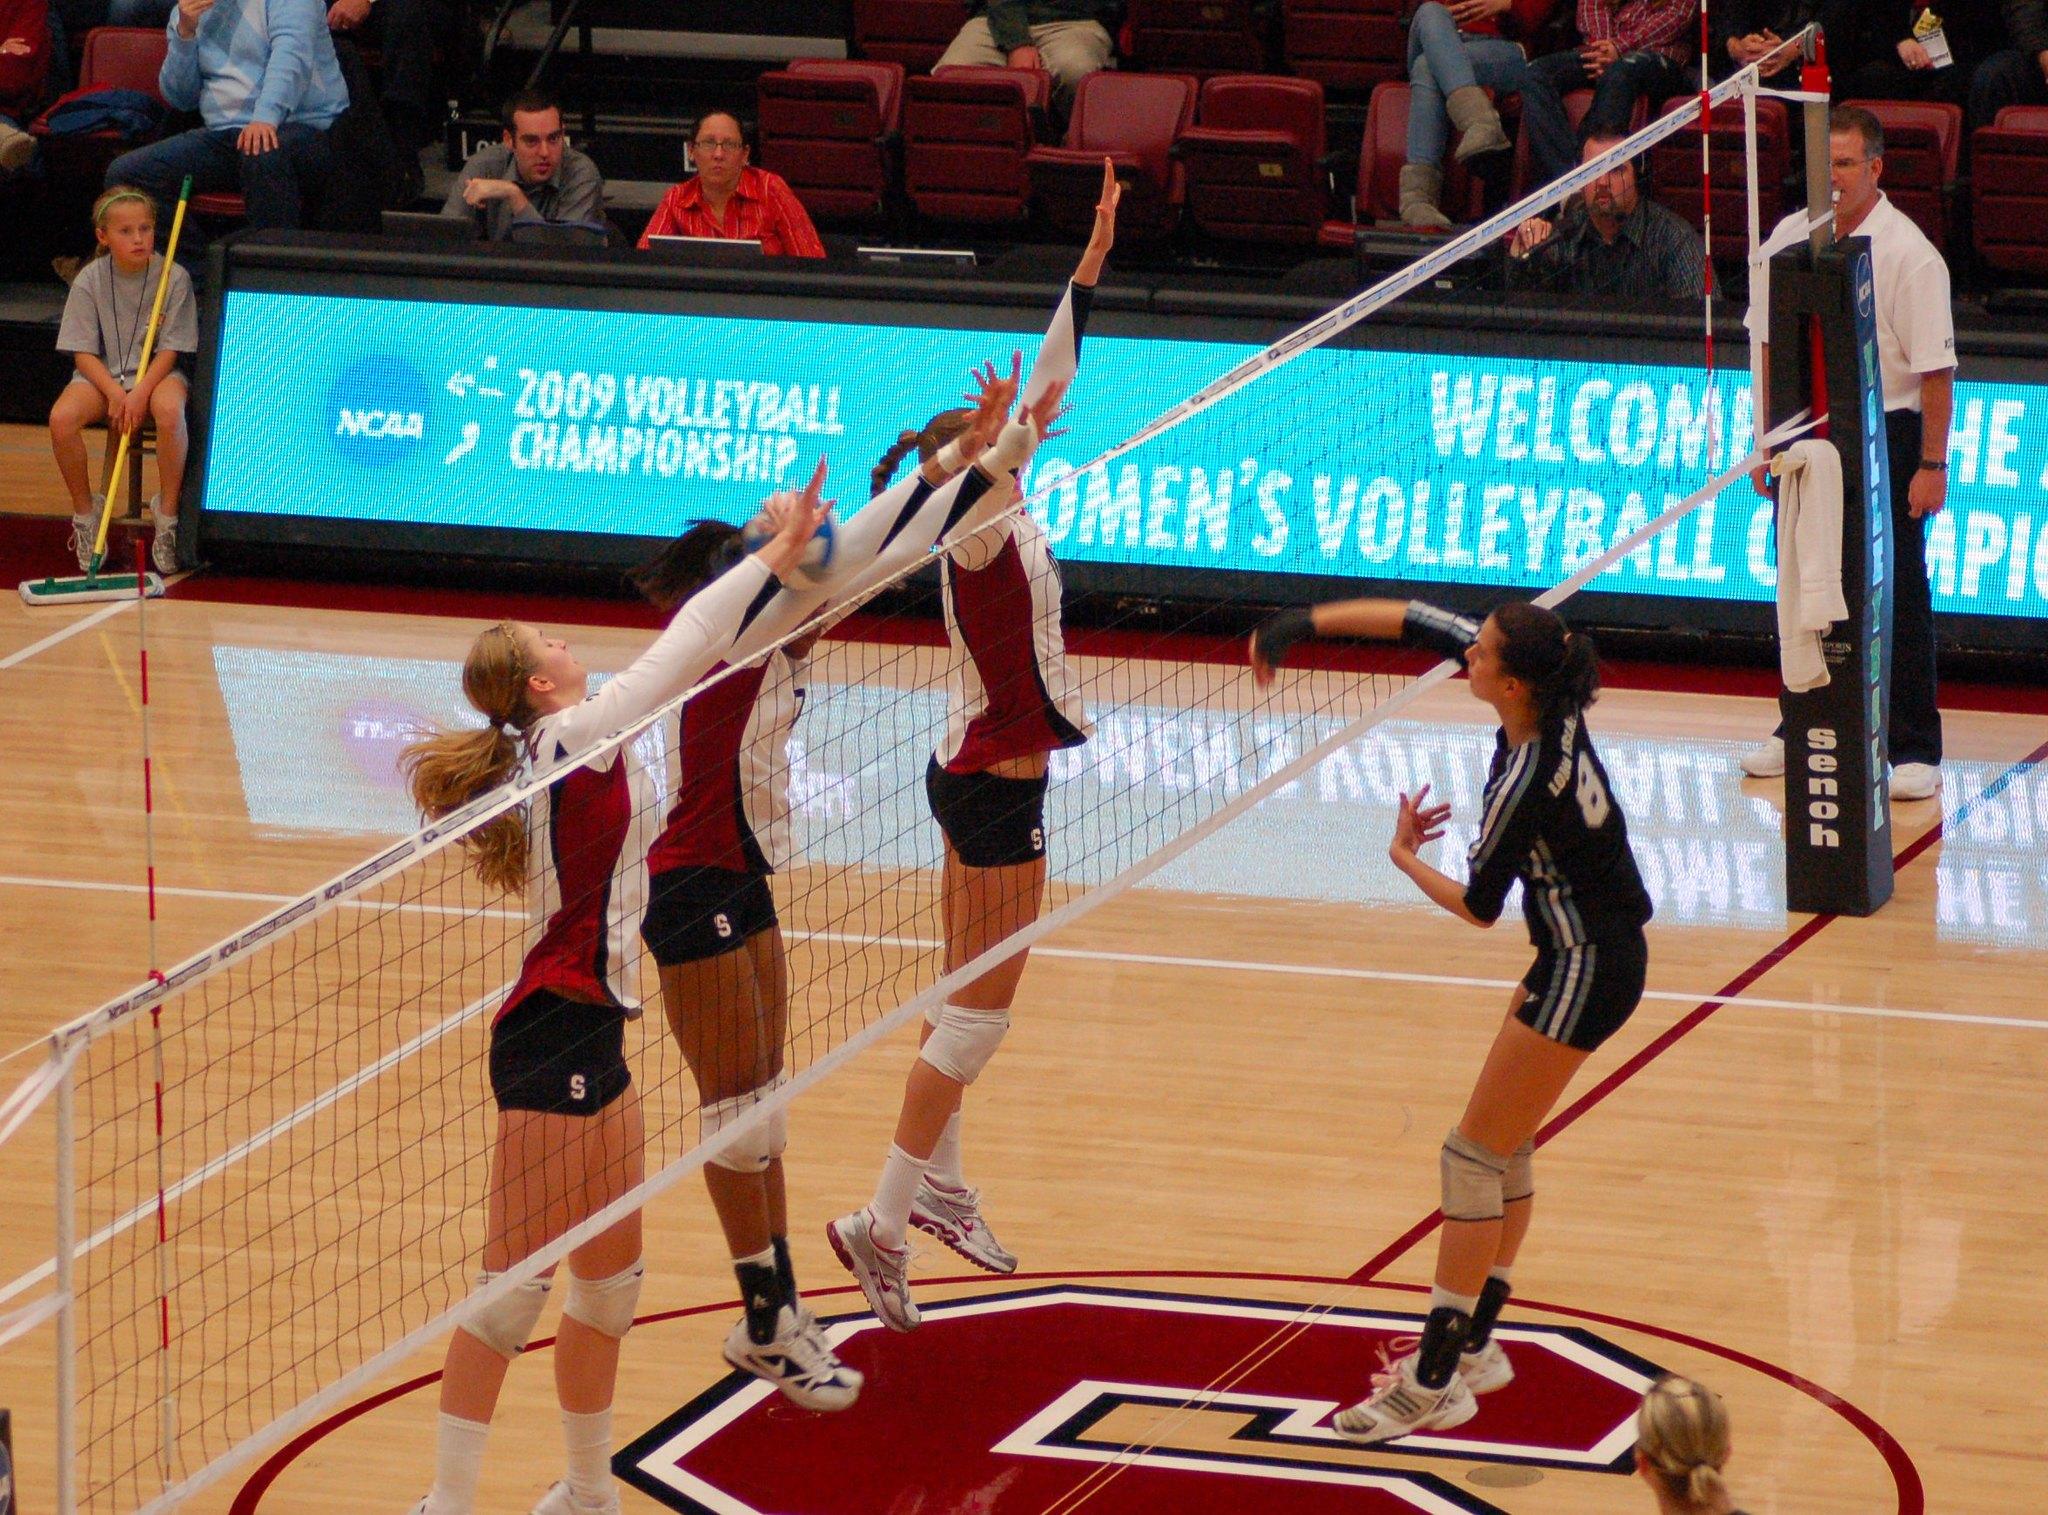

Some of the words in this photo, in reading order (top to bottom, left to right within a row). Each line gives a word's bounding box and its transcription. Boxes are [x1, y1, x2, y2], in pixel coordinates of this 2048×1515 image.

[336, 408, 424, 439] NCAA
[513, 368, 617, 421] 2009
[625, 375, 845, 435] VOLLEYBALL
[510, 421, 797, 483] CHAMPIONSHIP
[1022, 456, 1292, 557] OMEN'S
[1313, 473, 1726, 583] VOLLEYBALL
[1575, 750, 1611, 829] 8
[1807, 727, 1840, 848] senoh
[1030, 827, 1043, 851] S
[713, 913, 732, 938] S
[570, 1074, 586, 1100] S
